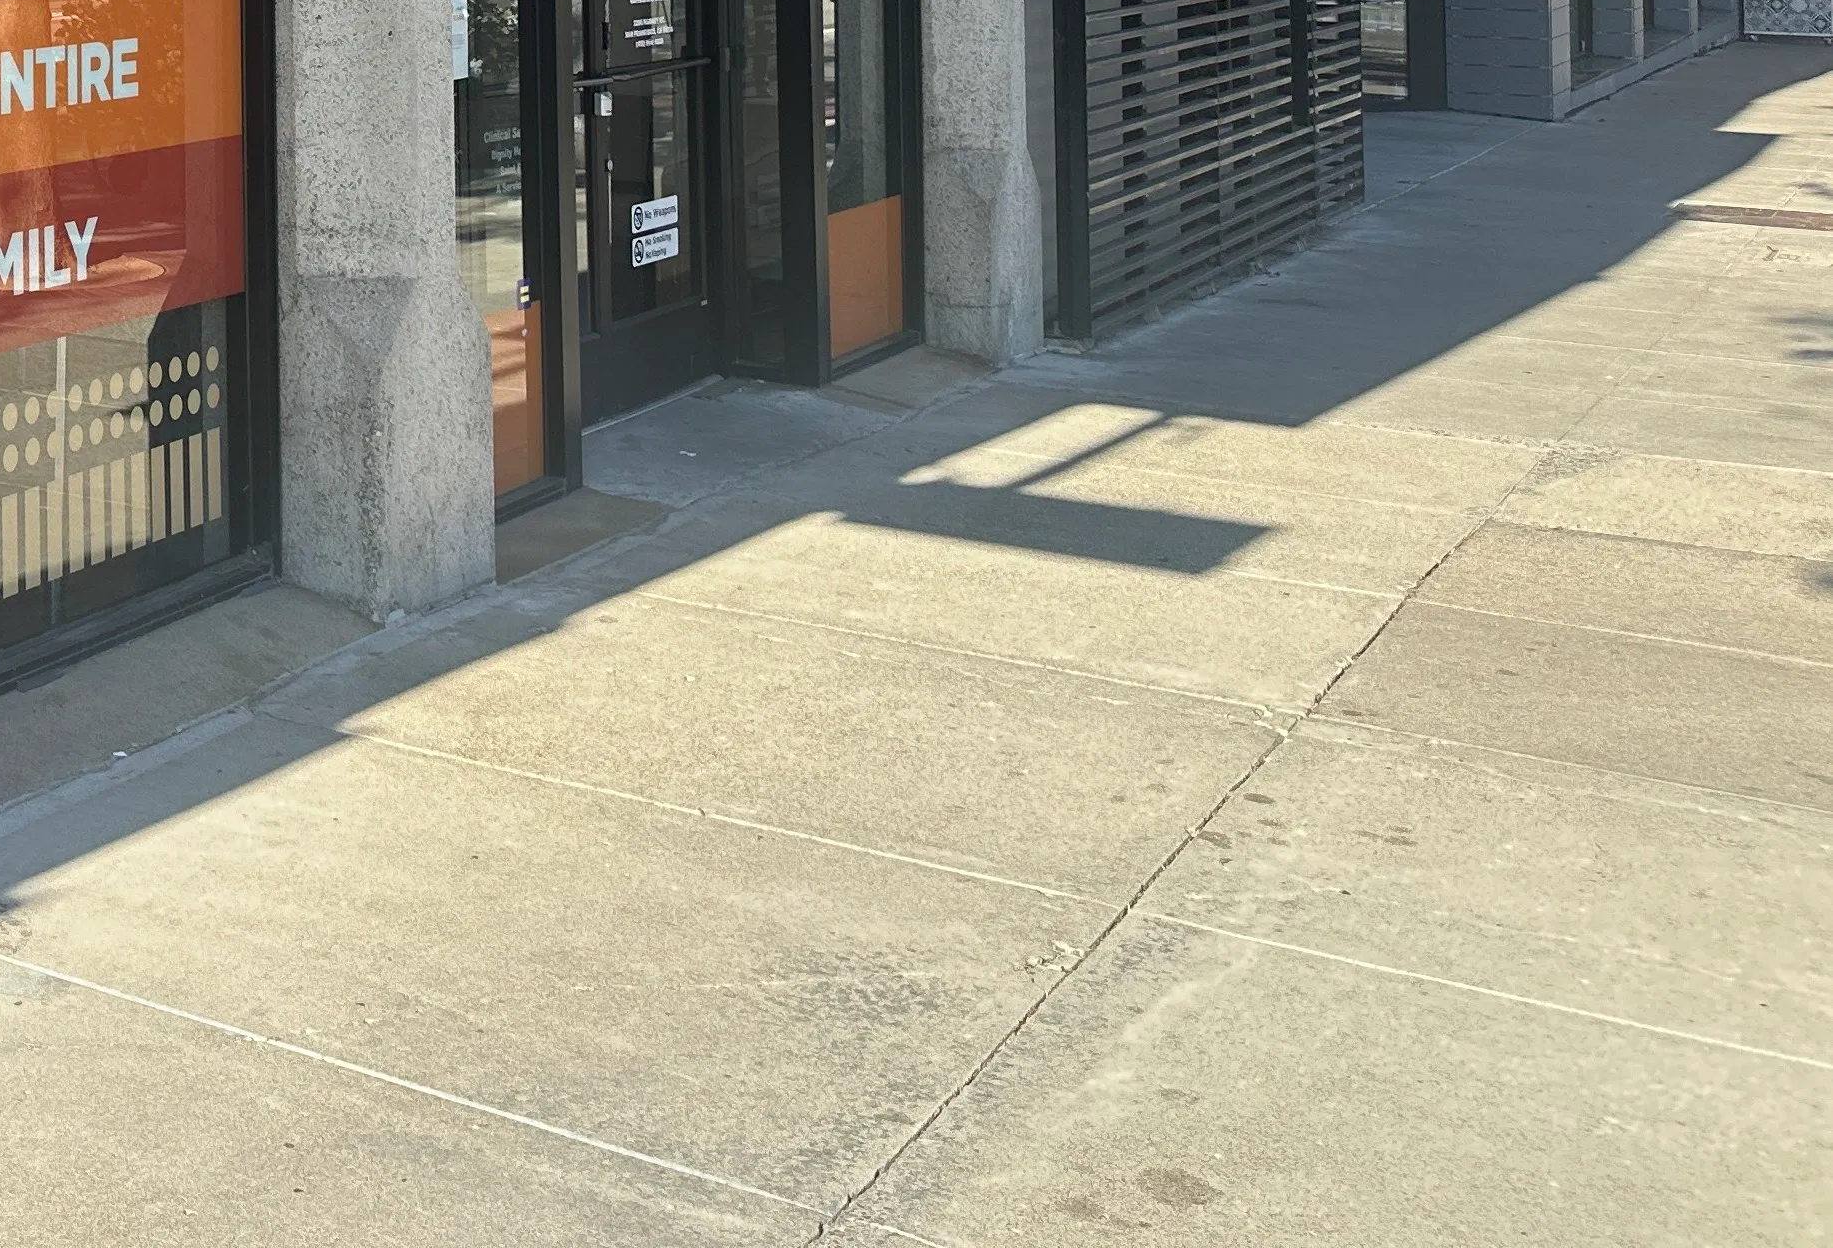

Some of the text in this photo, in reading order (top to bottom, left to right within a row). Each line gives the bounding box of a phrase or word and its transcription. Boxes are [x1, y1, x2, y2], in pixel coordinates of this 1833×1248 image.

[644, 210, 653, 220] No
[644, 233, 672, 247] No Smoking
